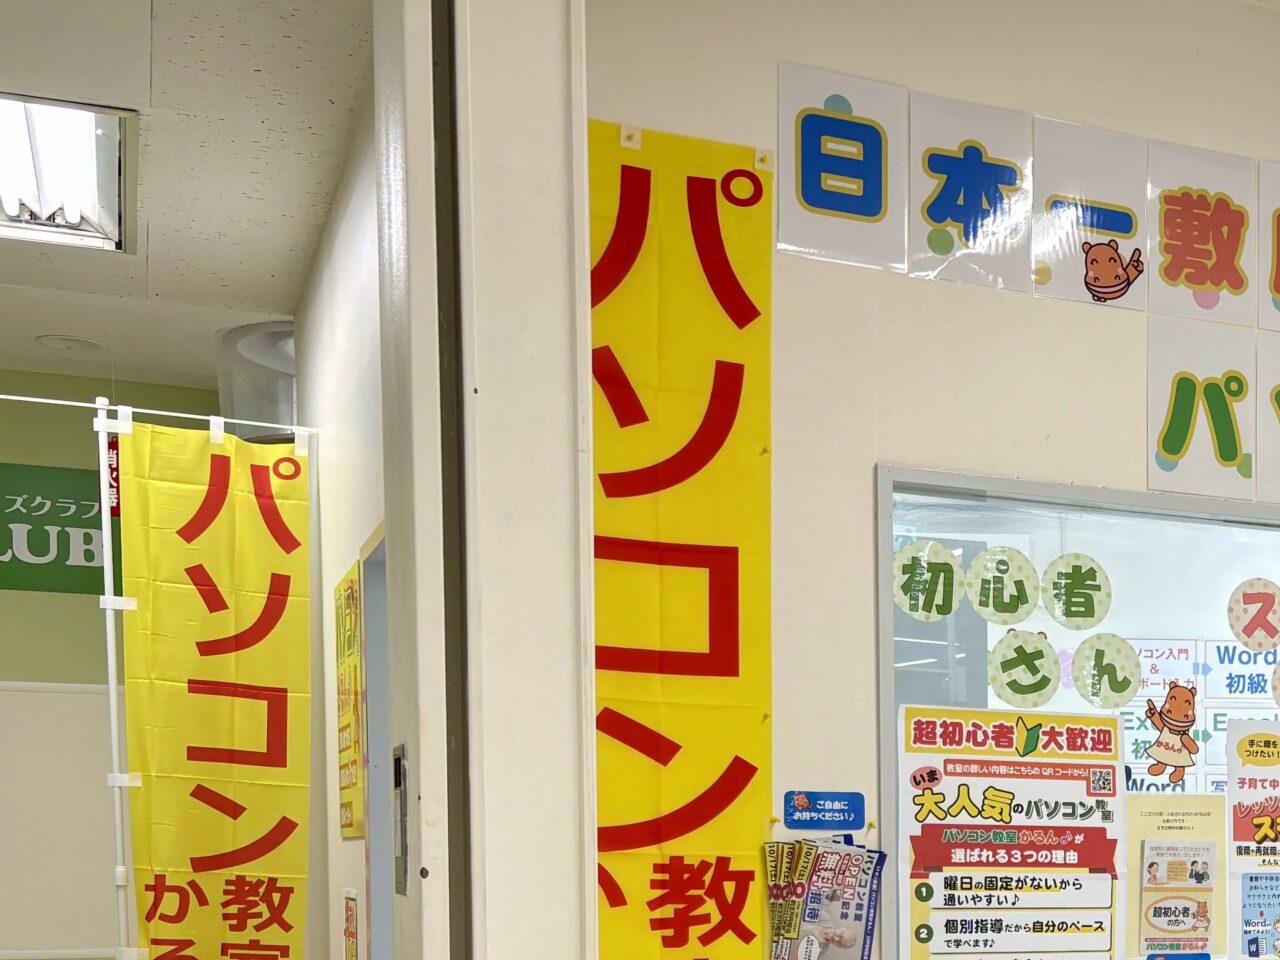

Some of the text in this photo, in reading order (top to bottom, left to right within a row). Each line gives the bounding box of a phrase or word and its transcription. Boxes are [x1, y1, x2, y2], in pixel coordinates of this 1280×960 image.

[900, 556, 1102, 618] 初心者
[1216, 645, 1278, 665] Word
[1000, 644, 1132, 698] さん
[1225, 673, 1268, 694] 初級
[913, 718, 1015, 748] 超初心者
[1041, 724, 1113, 753] 大歓迎
[913, 769, 940, 784] いま
[816, 800, 848, 810] ご自由に
[812, 851, 841, 892] 無料
[843, 854, 864, 901] OPEN
[854, 854, 876, 922] パソコン教室
[943, 876, 1083, 891] 曜日の固定がないから
[805, 891, 824, 922] 招待
[1153, 906, 1190, 918] 超初心者
[944, 919, 1105, 934] 個別指導だから自分のペース
[1244, 919, 1267, 927] Word
